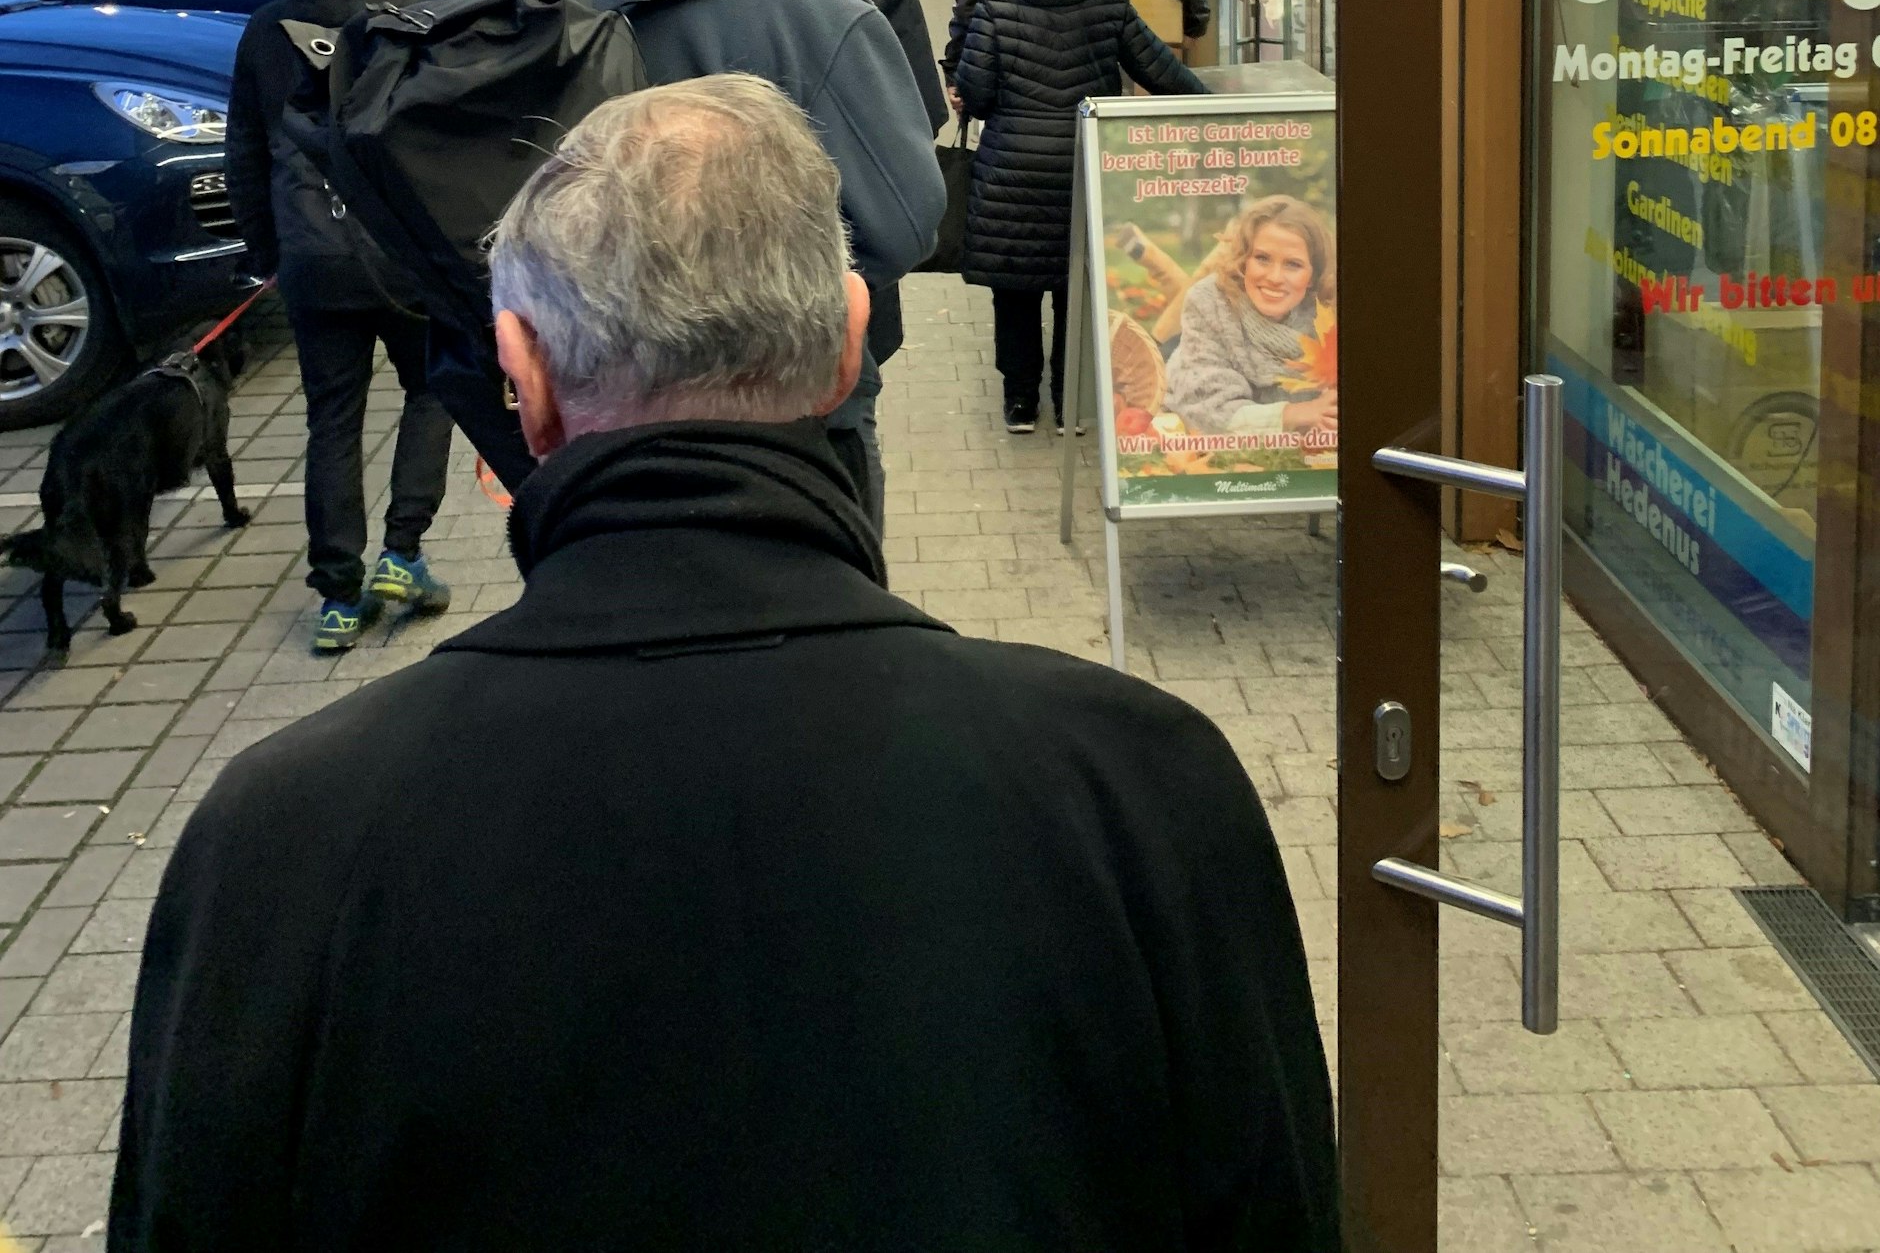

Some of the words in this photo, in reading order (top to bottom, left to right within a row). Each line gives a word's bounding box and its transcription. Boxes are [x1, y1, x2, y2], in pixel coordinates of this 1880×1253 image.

[1553, 35, 1858, 85] Montag-Freitag
[1128, 125, 1153, 144] Ist
[1159, 123, 1199, 142] Ihre
[1204, 120, 1312, 141] Garderobe
[1593, 112, 1816, 160] Sonnabend
[1831, 111, 1877, 148] 08
[1102, 152, 1164, 171] bereit
[1168, 150, 1199, 173] für
[1204, 148, 1234, 168] die
[1240, 148, 1301, 167] bunte
[1134, 175, 1248, 202] Jahreszeit?
[1628, 180, 1703, 250] Gardinen
[1640, 272, 1705, 314] Wir
[1719, 270, 1836, 309] bitten
[1118, 436, 1156, 454] Wir
[1161, 433, 1260, 453] kümmern
[1265, 432, 1300, 448] uns
[1214, 480, 1278, 494] Multimatic
[1607, 403, 1716, 537] Wäscherei
[1607, 451, 1701, 576] Hedenus
